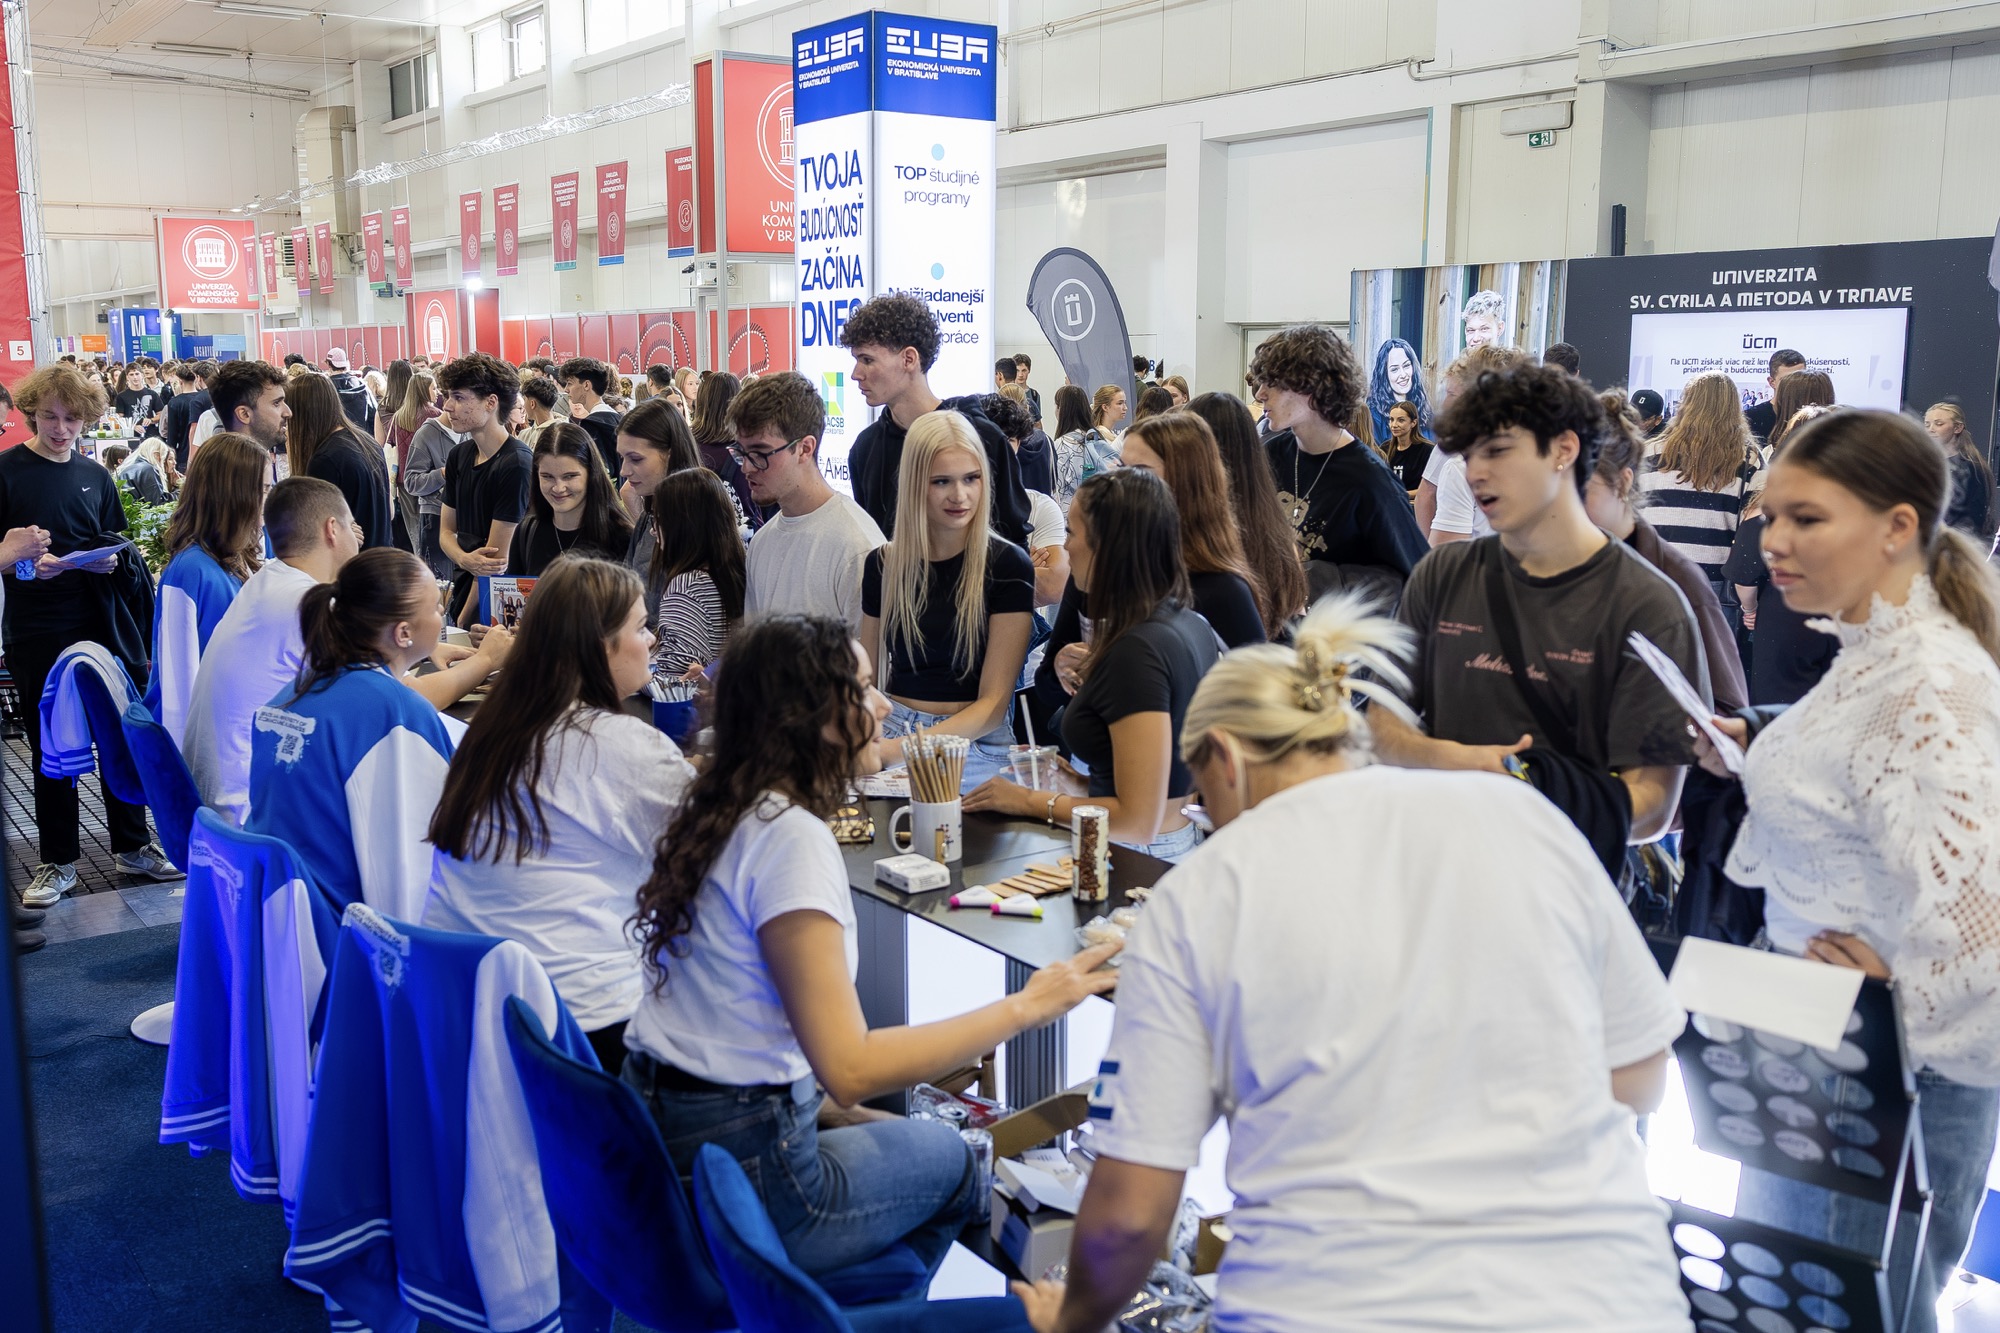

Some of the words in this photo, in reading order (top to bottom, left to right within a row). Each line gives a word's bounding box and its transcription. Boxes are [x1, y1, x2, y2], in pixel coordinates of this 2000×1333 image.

[798, 67, 830, 82] EKONOMICKÁ
[830, 60, 859, 75] UNIVERZITA
[887, 58, 939, 72] EKONOMICKÁ
[940, 64, 981, 76] UNIVERZITA
[887, 67, 894, 75] V
[894, 68, 939, 80] BRATISLAVE
[803, 75, 831, 88] BRATISLAVE
[800, 149, 863, 193] TVOJA
[894, 165, 927, 180] TOP
[929, 168, 980, 185] študijné
[904, 190, 970, 208] programy
[800, 192, 864, 242] BUDÚCNOSŤ
[765, 229, 775, 241] V
[801, 246, 864, 291] ZAČÍNA
[1712, 267, 1818, 285] UNIVERZITA
[187, 288, 240, 297] KOMENSKÉHO
[191, 283, 234, 291] UNIVERZITA
[196, 296, 238, 304] BRATISLAVE
[888, 287, 985, 306] Njžiadanejší
[1629, 295, 1655, 309] SV.
[1658, 293, 1716, 309] CYRILA
[1720, 293, 1732, 307] A
[1736, 290, 1814, 307] METODA
[1818, 289, 1831, 304] V
[1837, 287, 1913, 303] TRNAVE
[16, 346, 25, 355] 5
[1670, 358, 1681, 366] Na
[1681, 358, 1699, 366] UCM
[1700, 357, 1723, 366] získaš
[1725, 358, 1740, 366] viac
[1742, 357, 1756, 366] než
[1757, 358, 1769, 366] len
